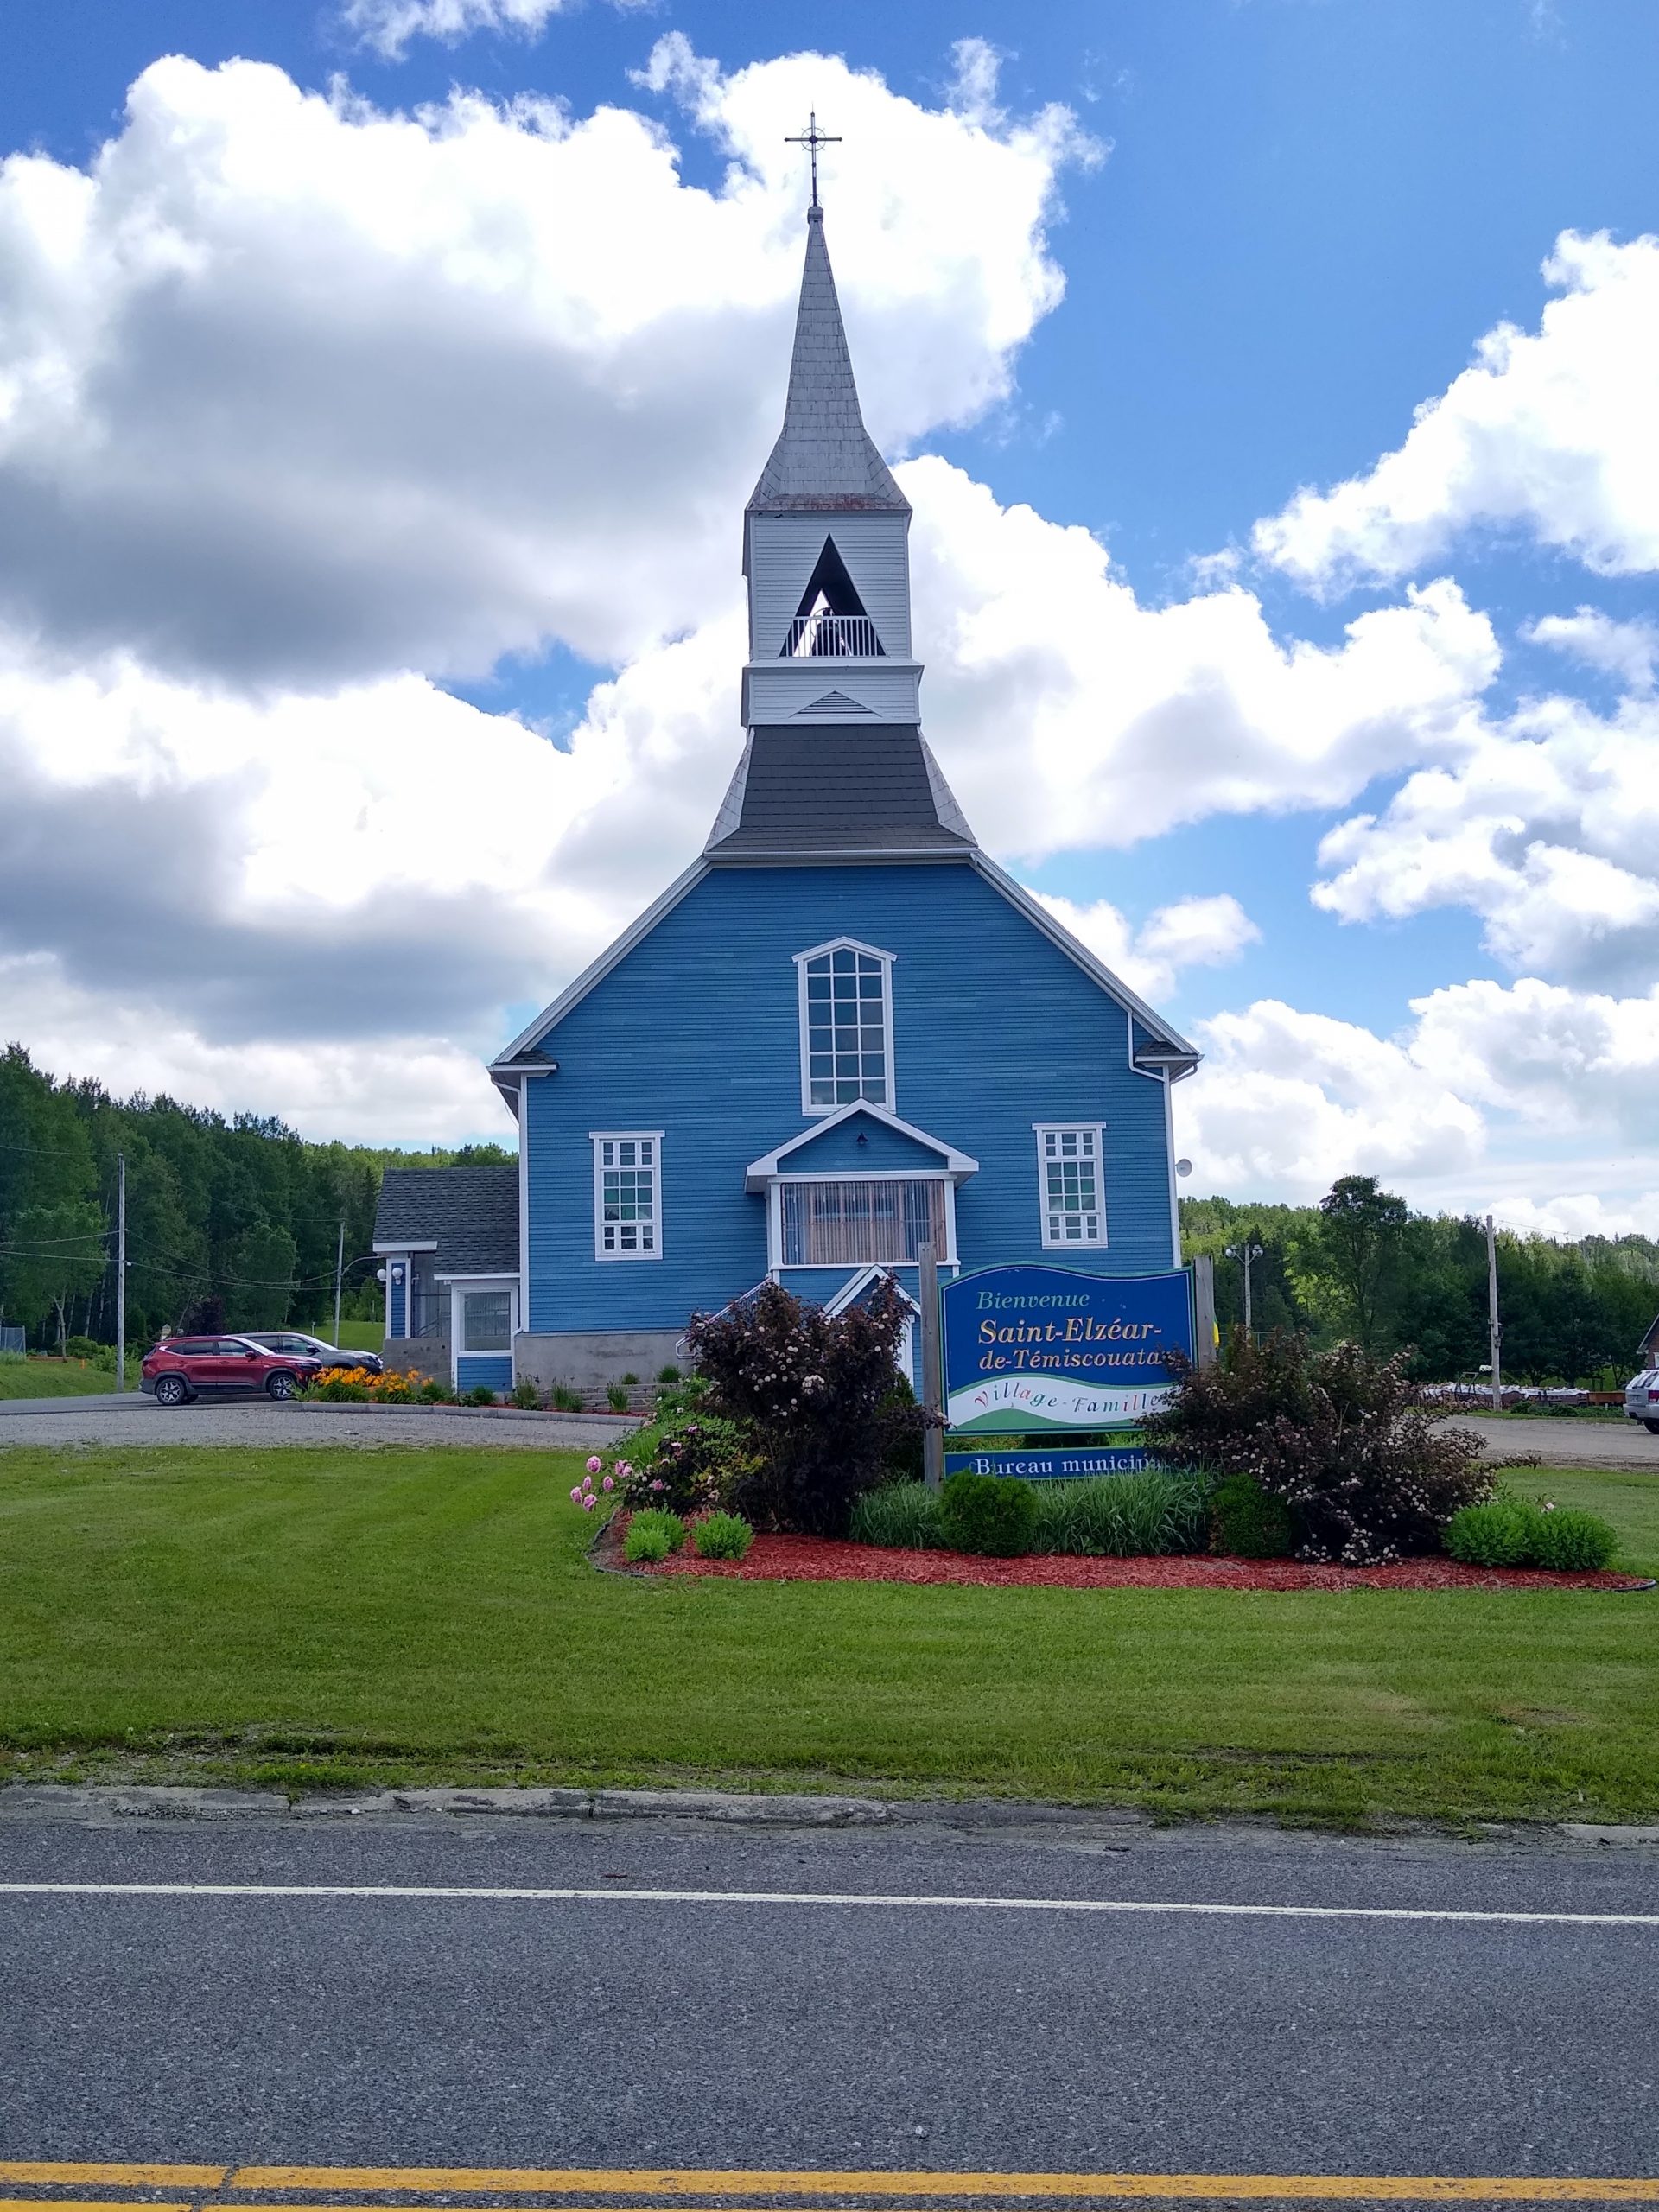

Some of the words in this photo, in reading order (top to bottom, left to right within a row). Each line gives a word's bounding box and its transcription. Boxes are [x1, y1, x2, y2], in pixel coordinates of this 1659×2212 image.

[976, 1291, 1090, 1310] Bienvenue
[978, 1316, 1162, 1344] Saint-Elzéar-
[979, 1348, 1162, 1370] de-Témiscouata
[975, 1458, 1053, 1475] Bureau
[1062, 1454, 1169, 1474] municip
